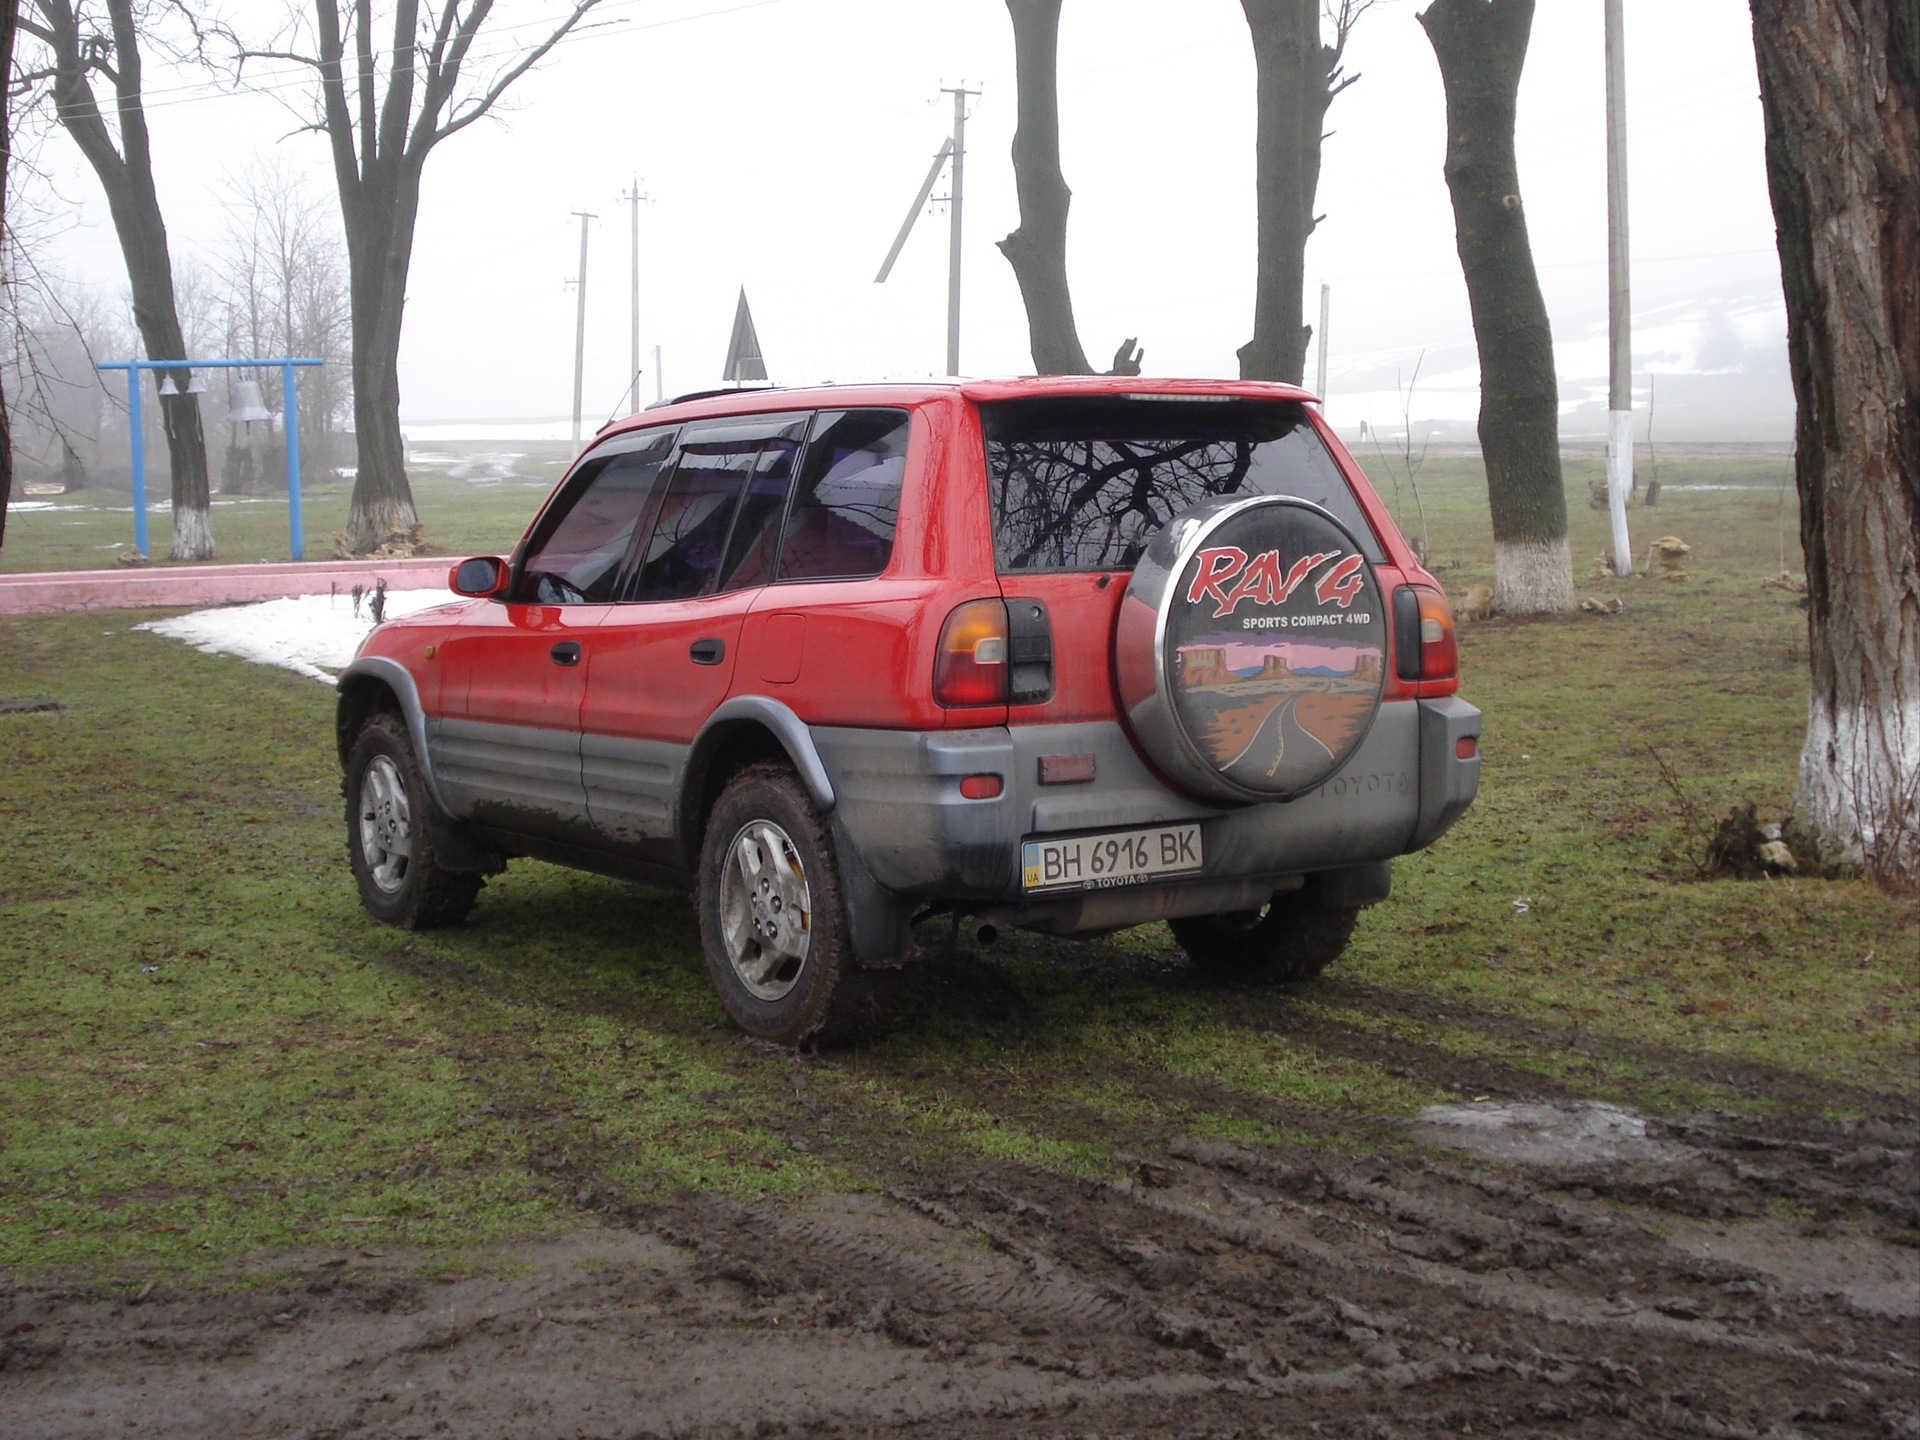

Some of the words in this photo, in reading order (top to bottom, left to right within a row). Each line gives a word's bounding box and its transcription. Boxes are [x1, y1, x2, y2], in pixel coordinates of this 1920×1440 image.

[1243, 616, 1288, 629] SPORTS
[1291, 614, 1343, 627] COMPACT
[1346, 613, 1370, 624] 4WD
[1044, 844, 1082, 880] BH
[1090, 836, 1148, 874] 6916
[1160, 830, 1197, 865] BK
[1027, 873, 1039, 883] UA
[1096, 875, 1136, 888] TOYOTA
